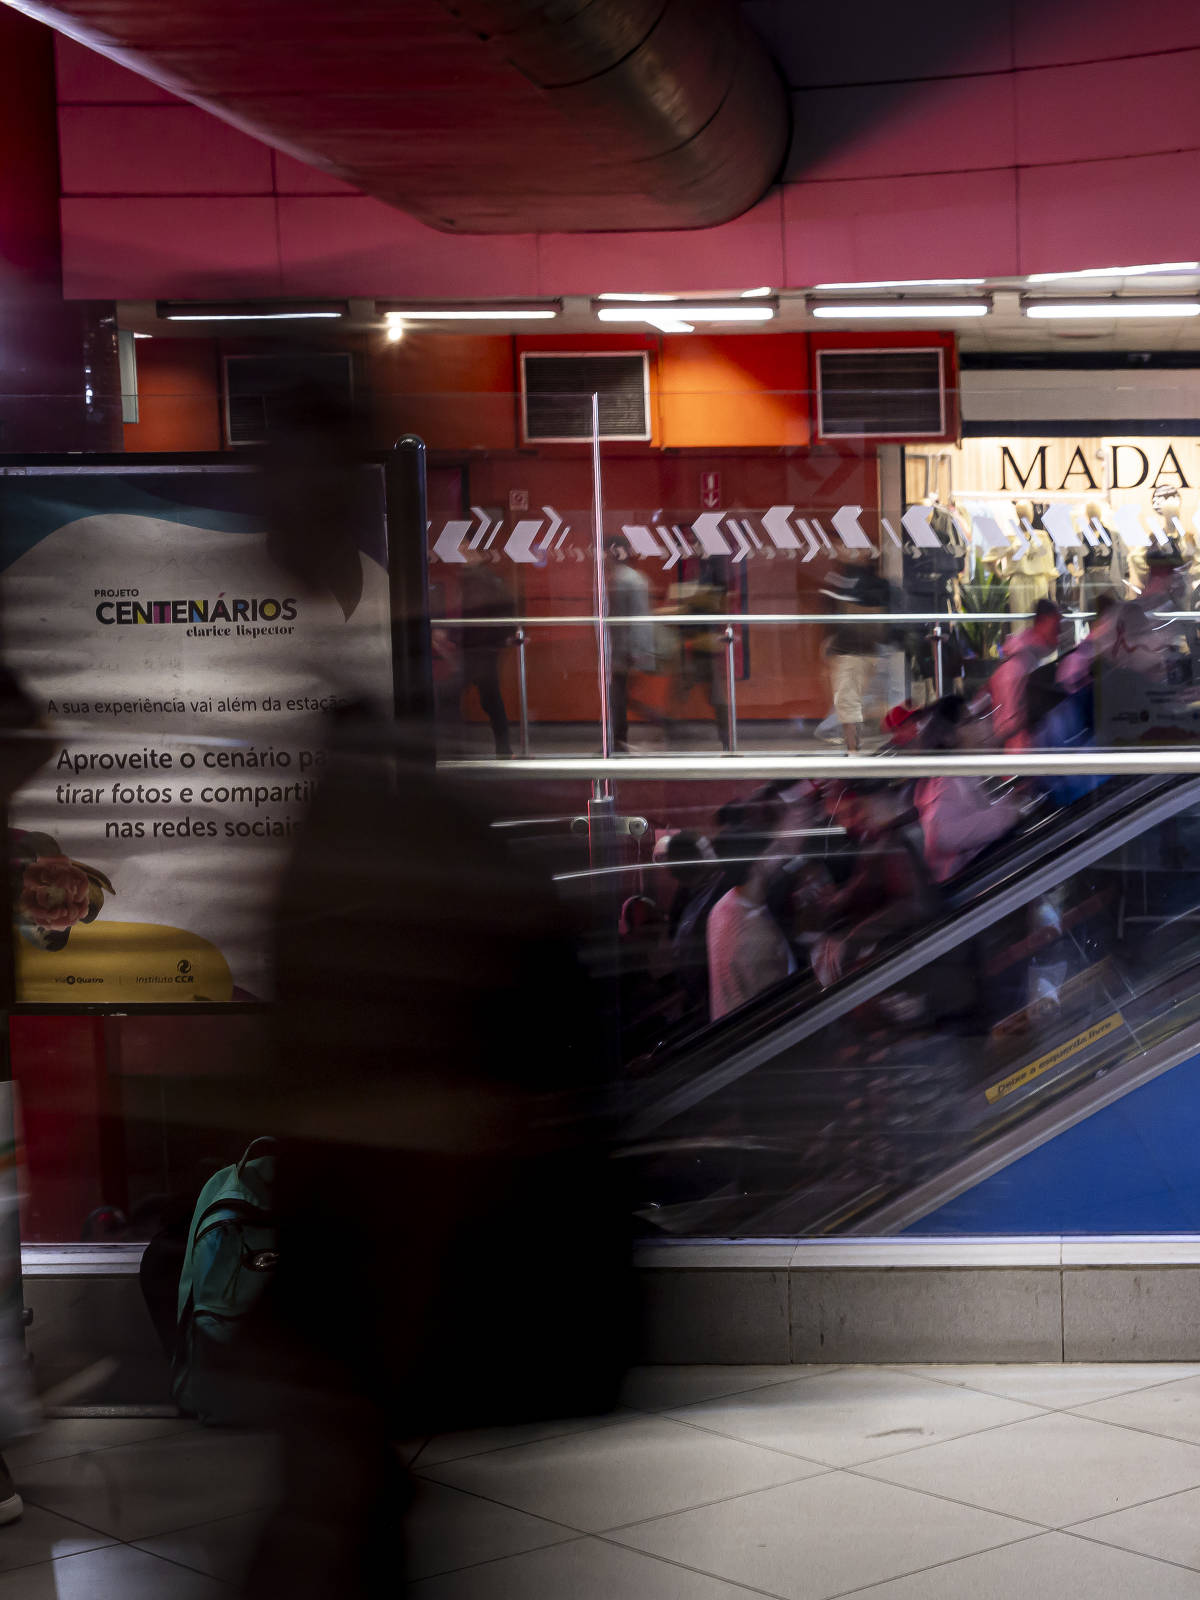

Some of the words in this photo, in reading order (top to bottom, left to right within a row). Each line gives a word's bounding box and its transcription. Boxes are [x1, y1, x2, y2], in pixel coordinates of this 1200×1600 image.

[94, 588, 139, 598] PROJETO
[96, 592, 297, 625] CENTENÁRIOS
[186, 624, 231, 637] clarice
[236, 624, 295, 639] lispector
[48, 700, 59, 713] A
[64, 702, 90, 714] sua
[94, 697, 186, 717] experiência
[190, 699, 213, 713] vai
[217, 696, 256, 713] além
[262, 697, 282, 712] da
[57, 748, 172, 774] Aproveite
[180, 753, 195, 768] o
[203, 747, 291, 768] cenário
[299, 752, 328, 773] pa
[56, 784, 104, 804] tirar
[112, 783, 172, 803] fotos
[180, 789, 192, 802] e
[200, 781, 322, 807] compartil
[105, 820, 145, 837] nas
[153, 817, 217, 837] redes
[136, 975, 174, 984] Instituto
[174, 975, 194, 984] CCR
